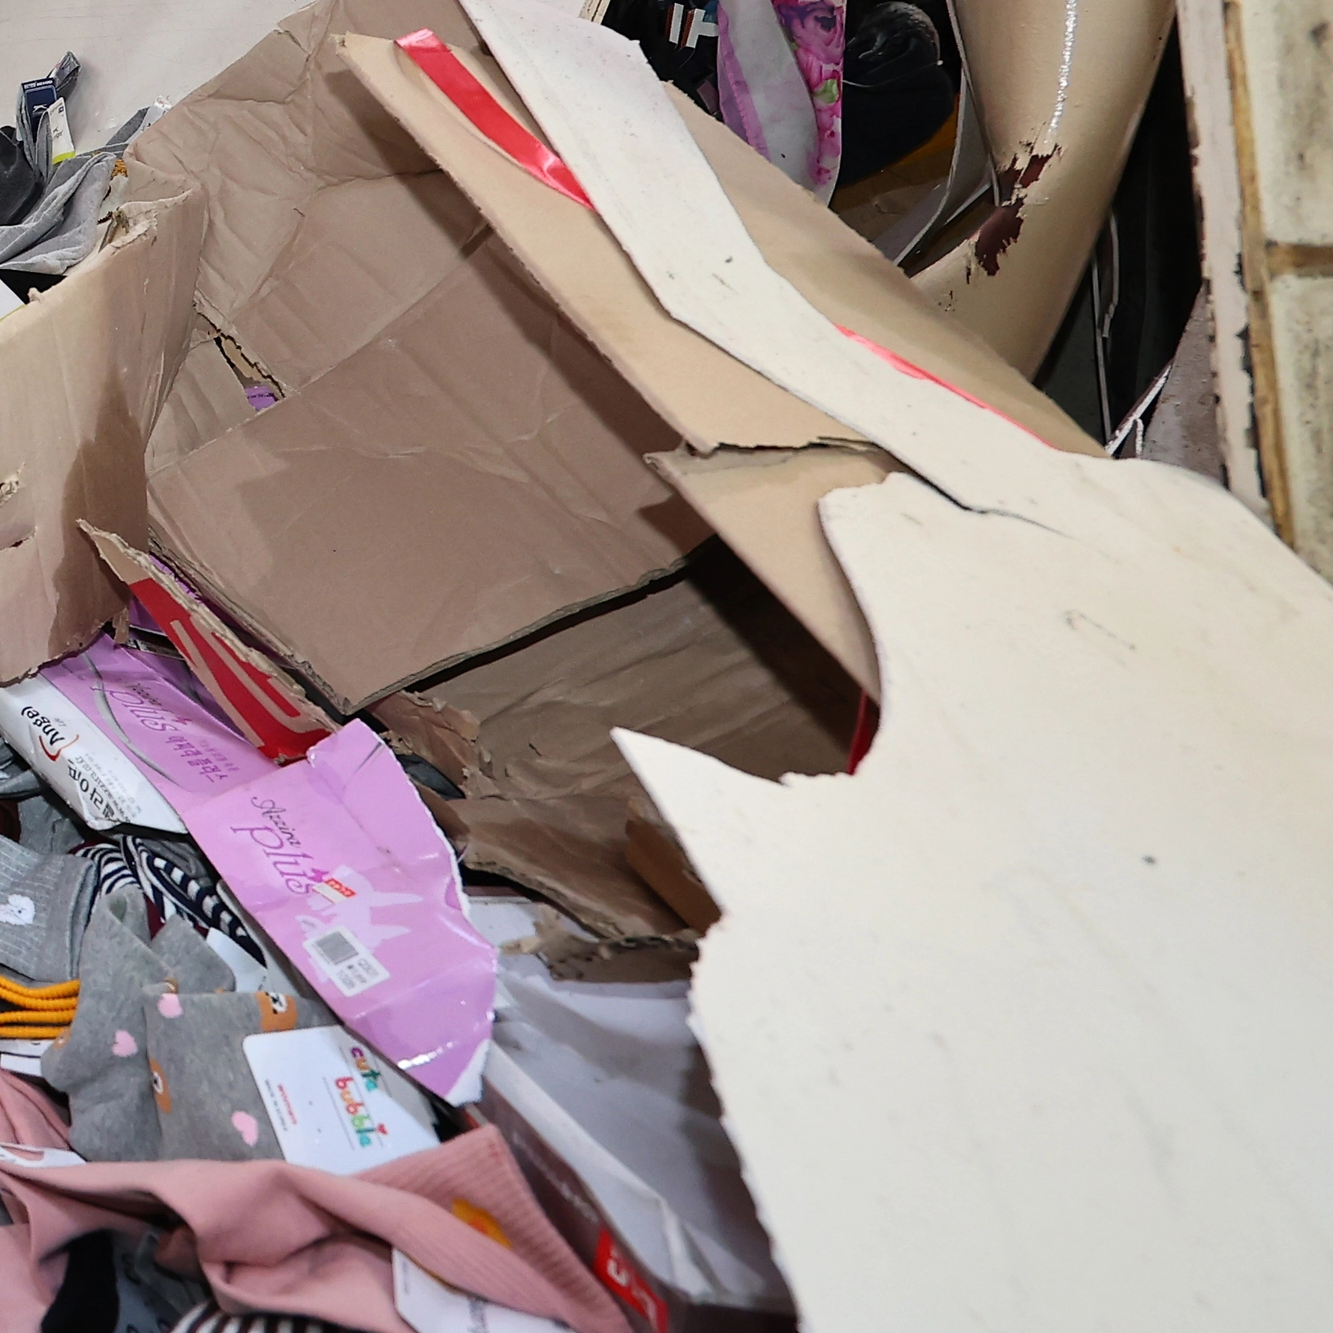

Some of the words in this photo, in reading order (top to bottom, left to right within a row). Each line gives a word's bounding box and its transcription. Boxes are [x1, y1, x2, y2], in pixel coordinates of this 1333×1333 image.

[250, 796, 302, 849] Azzira
[351, 1047, 381, 1092] cute
[335, 1075, 377, 1148] bubble
